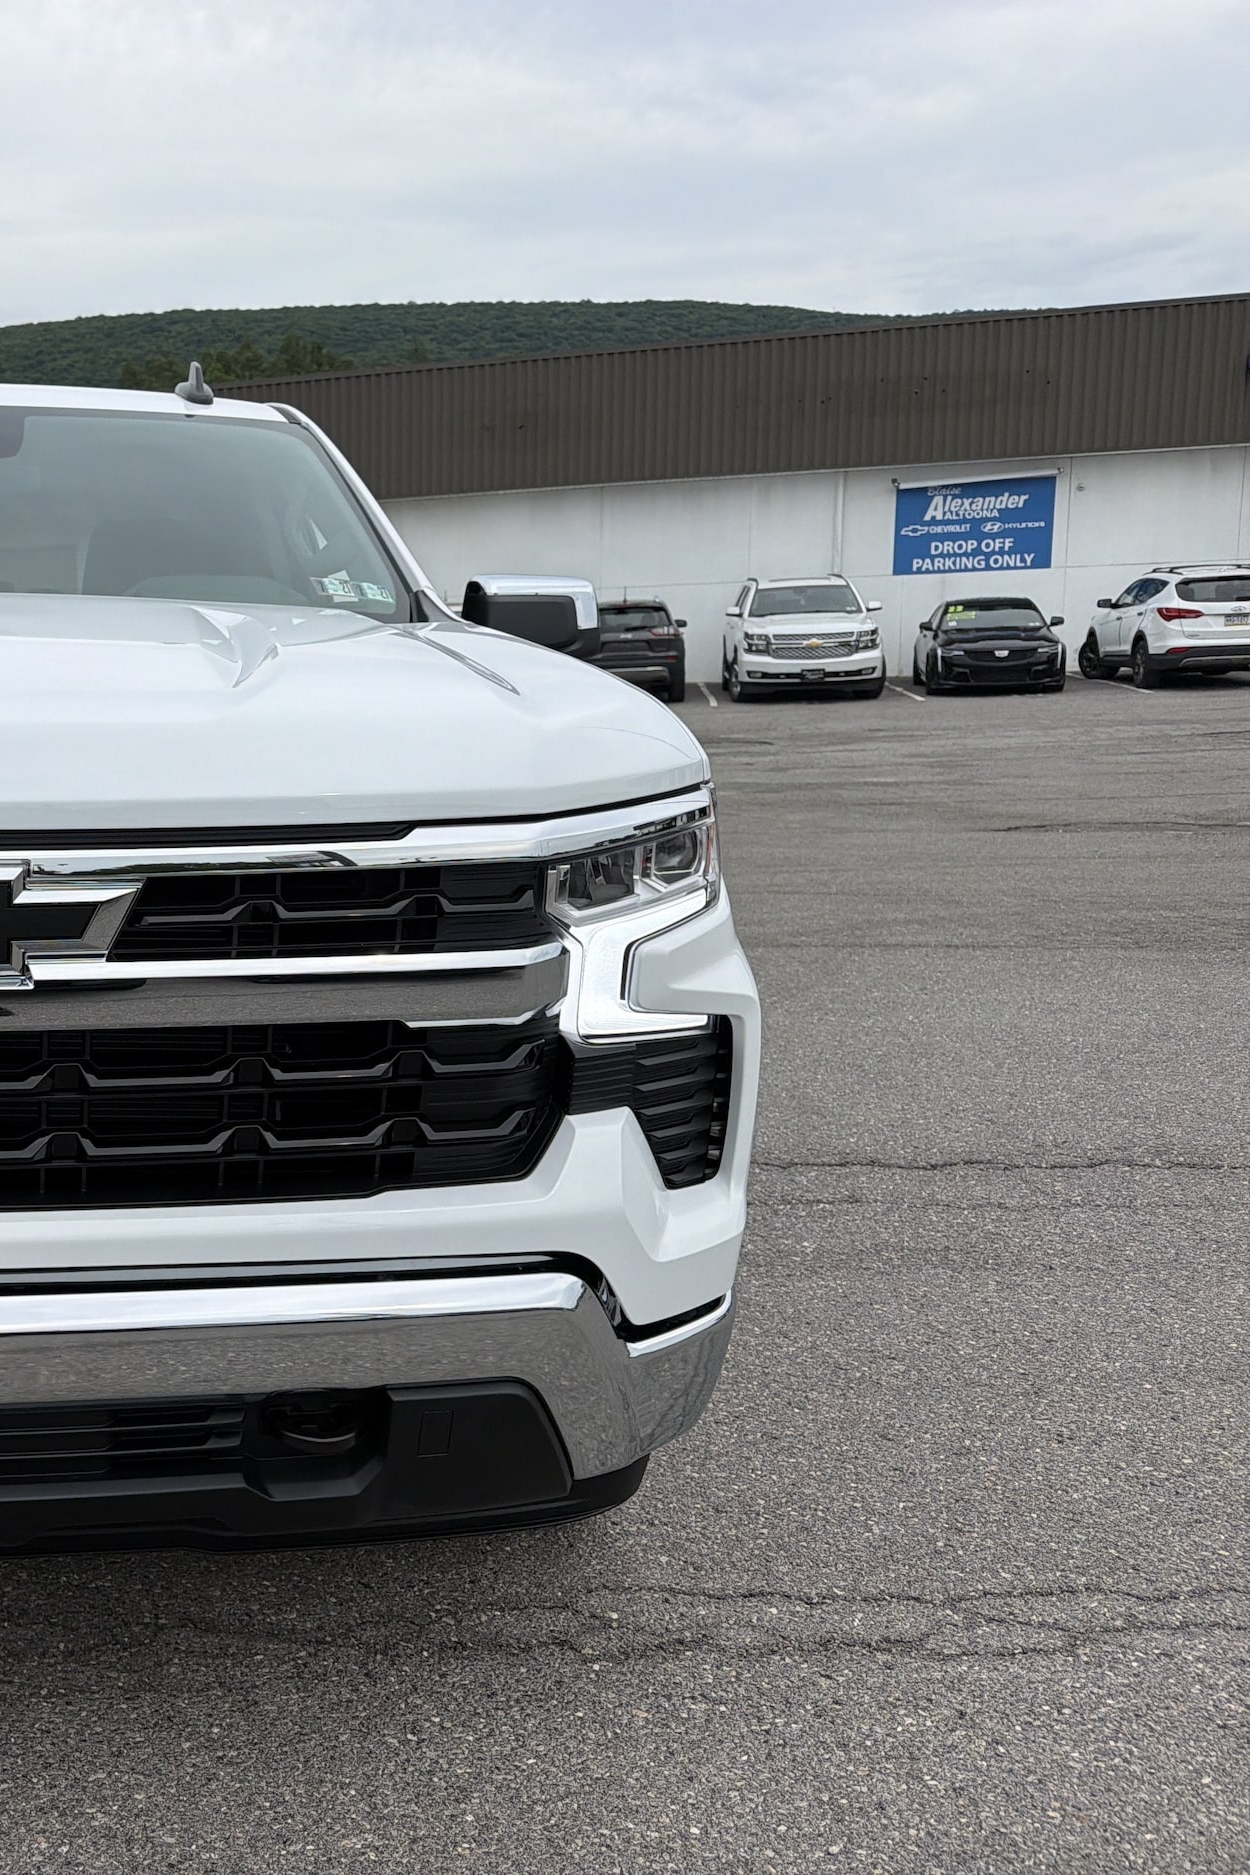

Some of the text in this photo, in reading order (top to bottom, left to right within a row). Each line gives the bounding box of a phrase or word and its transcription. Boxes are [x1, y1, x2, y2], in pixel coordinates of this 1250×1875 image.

[923, 492, 1029, 521] Alexander
[944, 509, 999, 520] ALTOONA
[929, 523, 971, 534] CHEVROLET
[1005, 521, 1046, 529] HYUNDAI
[930, 538, 1015, 555] DROP OFF
[912, 553, 1036, 572] PARKING ONLY
